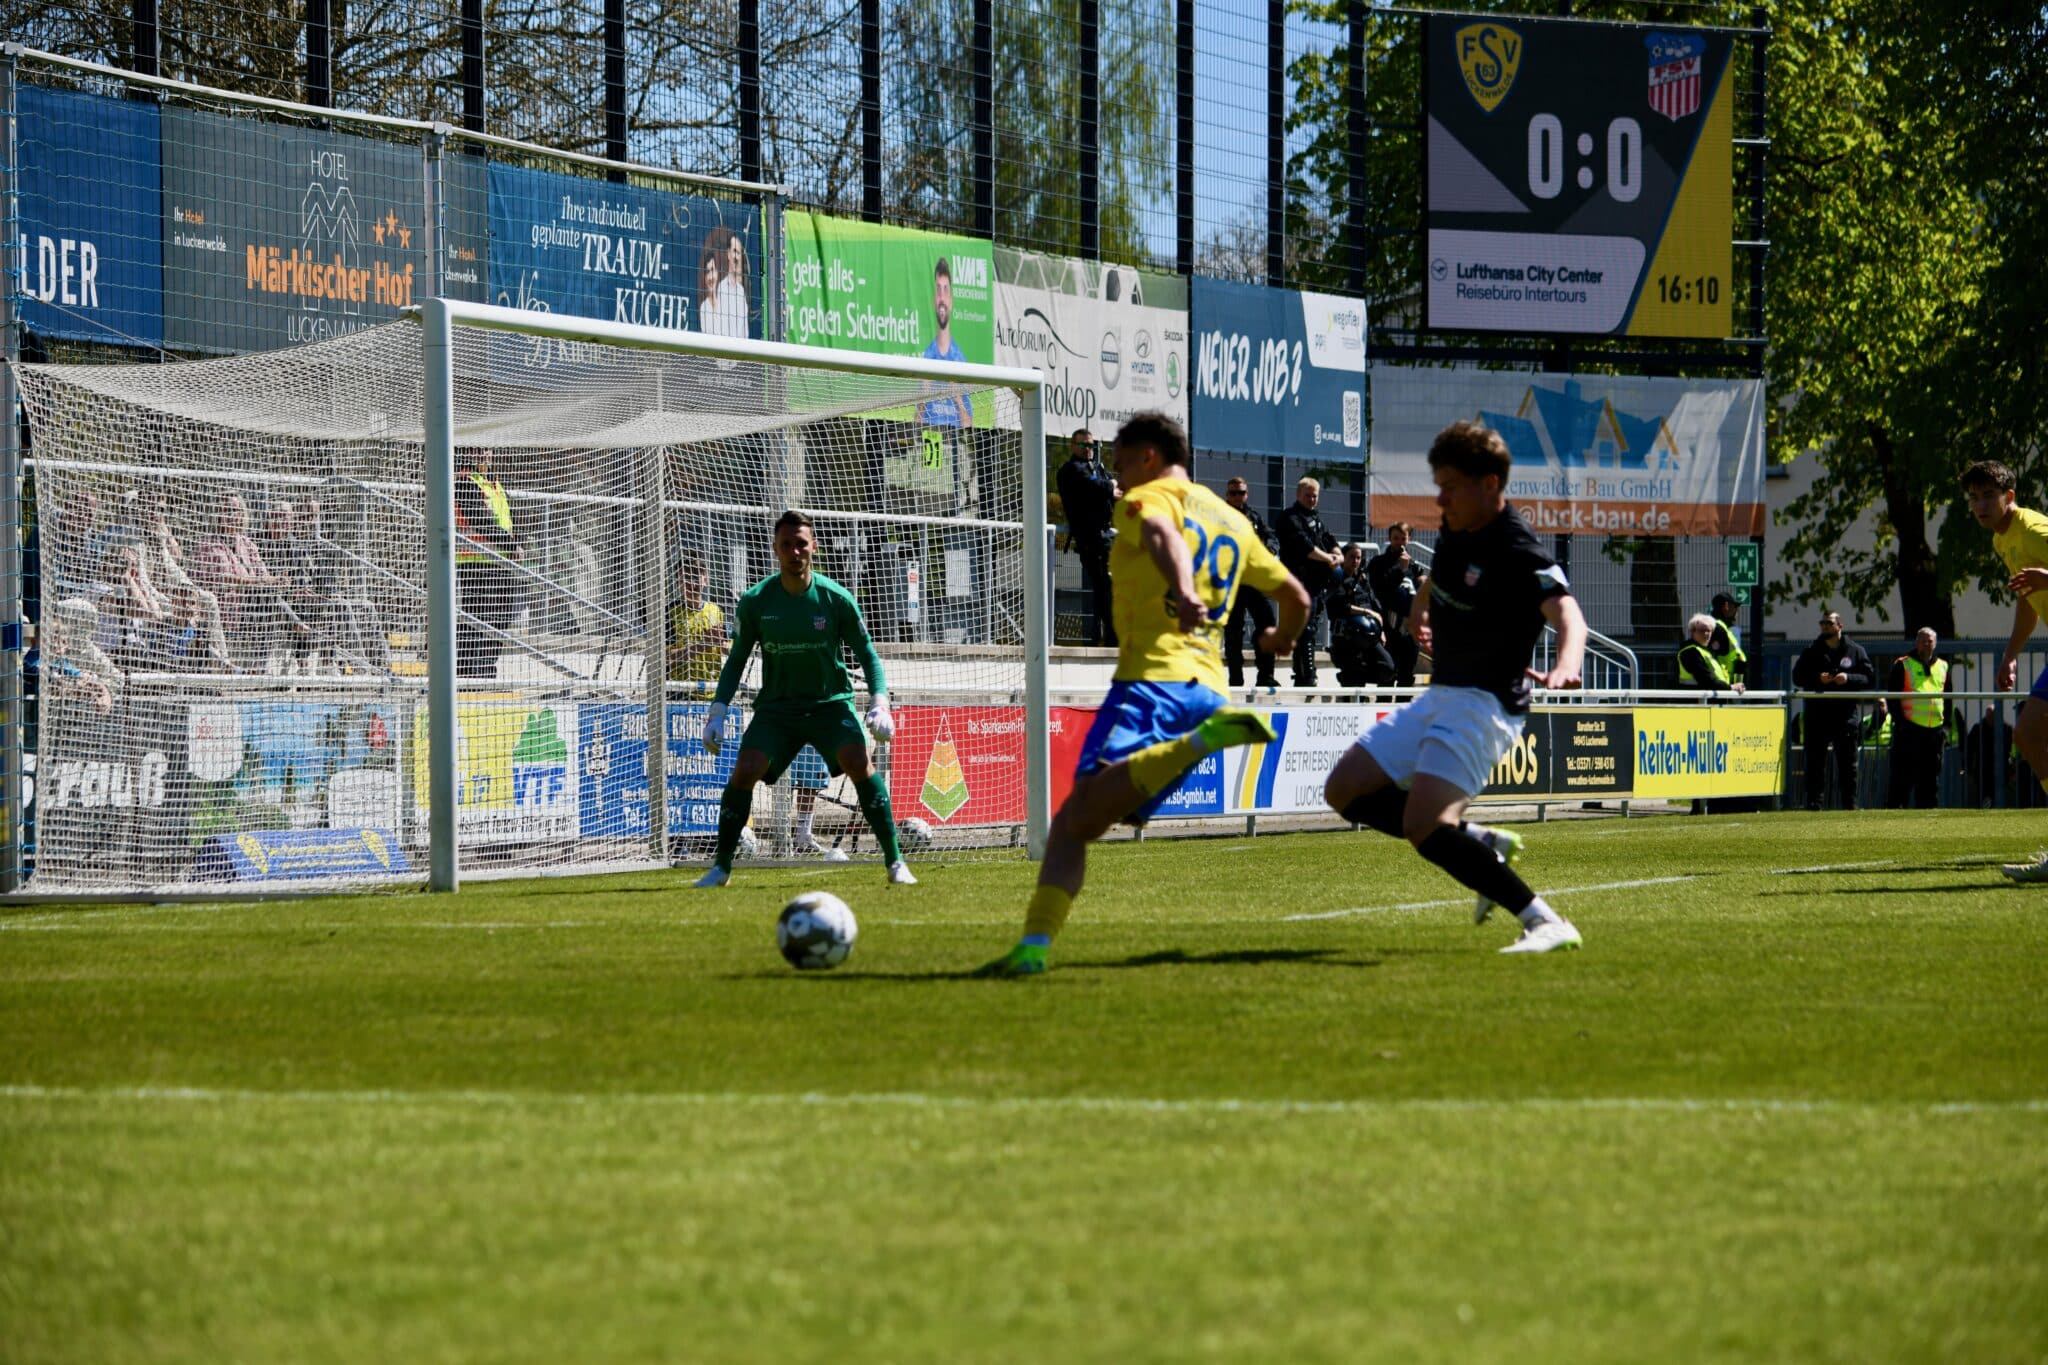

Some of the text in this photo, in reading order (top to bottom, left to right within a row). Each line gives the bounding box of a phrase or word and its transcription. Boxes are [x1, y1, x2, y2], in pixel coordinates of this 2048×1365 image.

[1653, 56, 1697, 79] FSV
[310, 149, 349, 182] HOTEL
[174, 206, 184, 223] Ihr
[561, 195, 646, 232] Ihre individuell
[174, 231, 227, 253] in Luckenwalde
[531, 223, 670, 281] geplante TRAUM-
[246, 244, 413, 308] Märkischer Hof
[792, 254, 822, 294] gebt
[828, 258, 855, 294] alles
[1456, 263, 1603, 287] Lufthansa City Center
[1456, 282, 1587, 303] Reisebüro Intertours
[1657, 275, 1719, 305] 16:10
[615, 281, 690, 332] KÜCHE
[799, 298, 841, 344] geben
[846, 302, 920, 345] Sicherheit!
[1197, 331, 1249, 401] NEUER
[1585, 478, 1615, 497] Bau
[1620, 479, 1671, 499] GmbH
[967, 719, 980, 734] Das
[1305, 712, 1359, 737] STÄDTISCHE
[1638, 729, 1729, 776] Reifen-Müller
